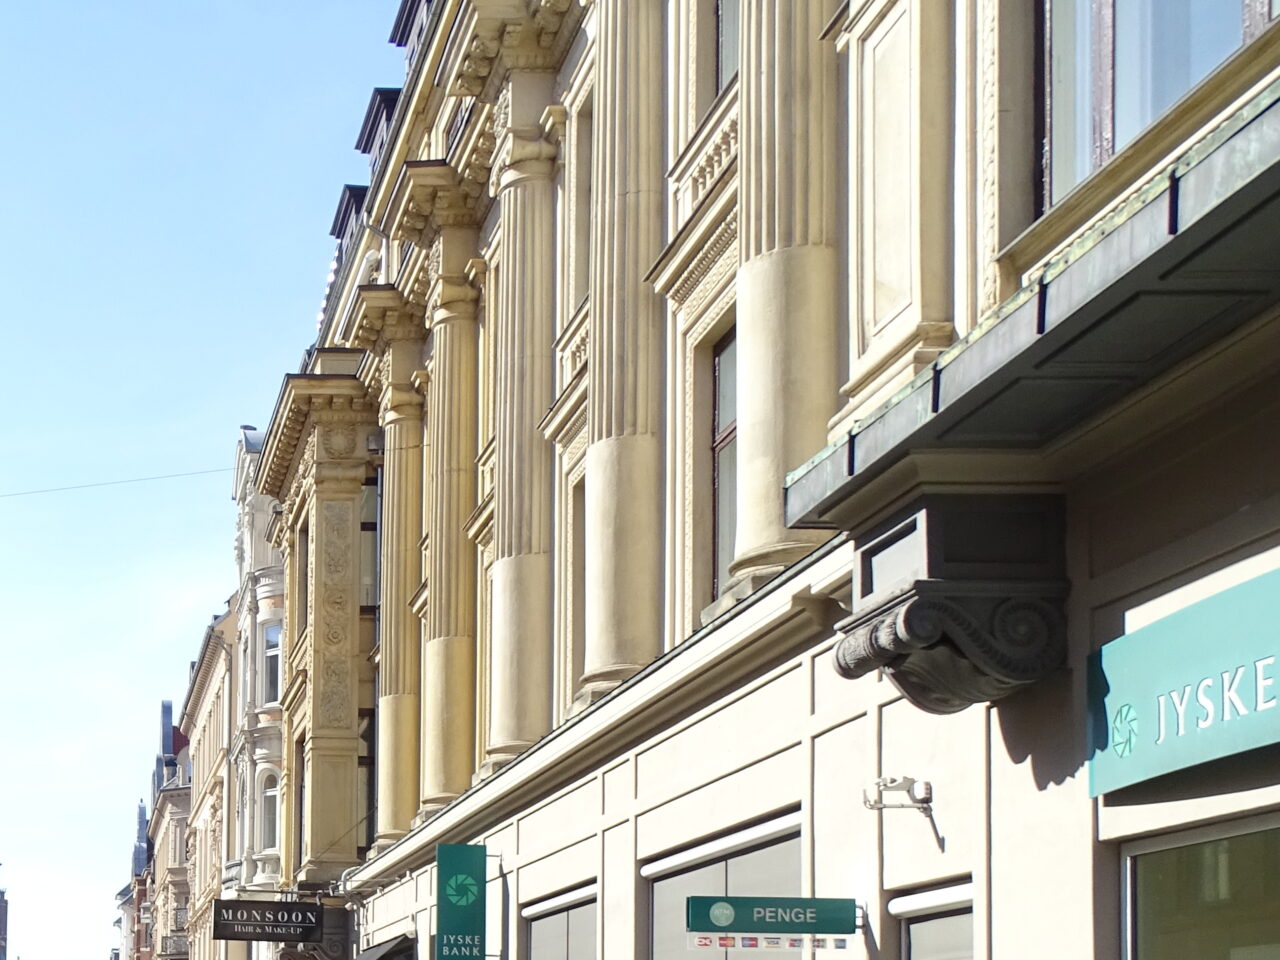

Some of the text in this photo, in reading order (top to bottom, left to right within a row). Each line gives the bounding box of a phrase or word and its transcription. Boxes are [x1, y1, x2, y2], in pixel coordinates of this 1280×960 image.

[1155, 655, 1277, 745] JYSKE
[221, 909, 316, 923] MONSOON
[753, 908, 816, 922] PENGE
[443, 935, 480, 944] JYSKE
[442, 946, 480, 956] BANK
